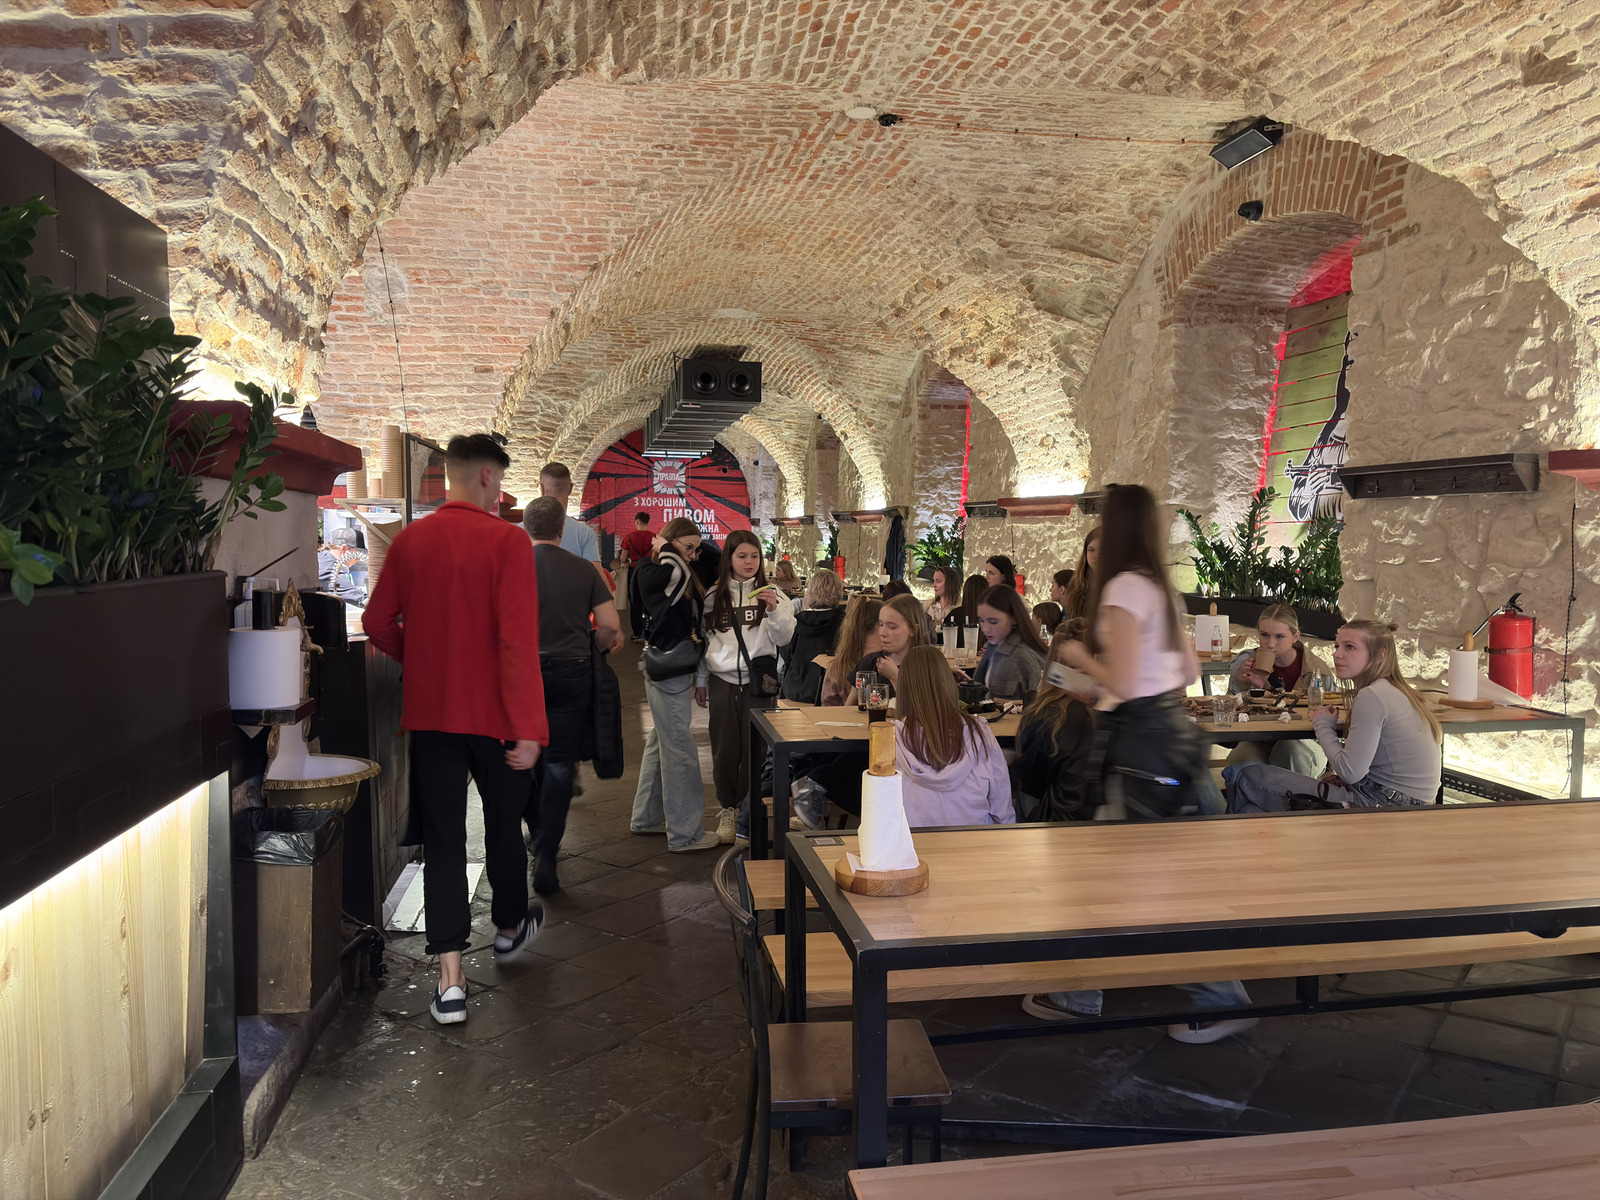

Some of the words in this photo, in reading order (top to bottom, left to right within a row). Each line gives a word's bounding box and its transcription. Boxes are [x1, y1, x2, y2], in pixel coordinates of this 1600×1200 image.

[641, 497, 686, 507] ХОРОШИМ
[663, 508, 715, 523] ПИВОМ
[696, 524, 719, 533] ЖНА
